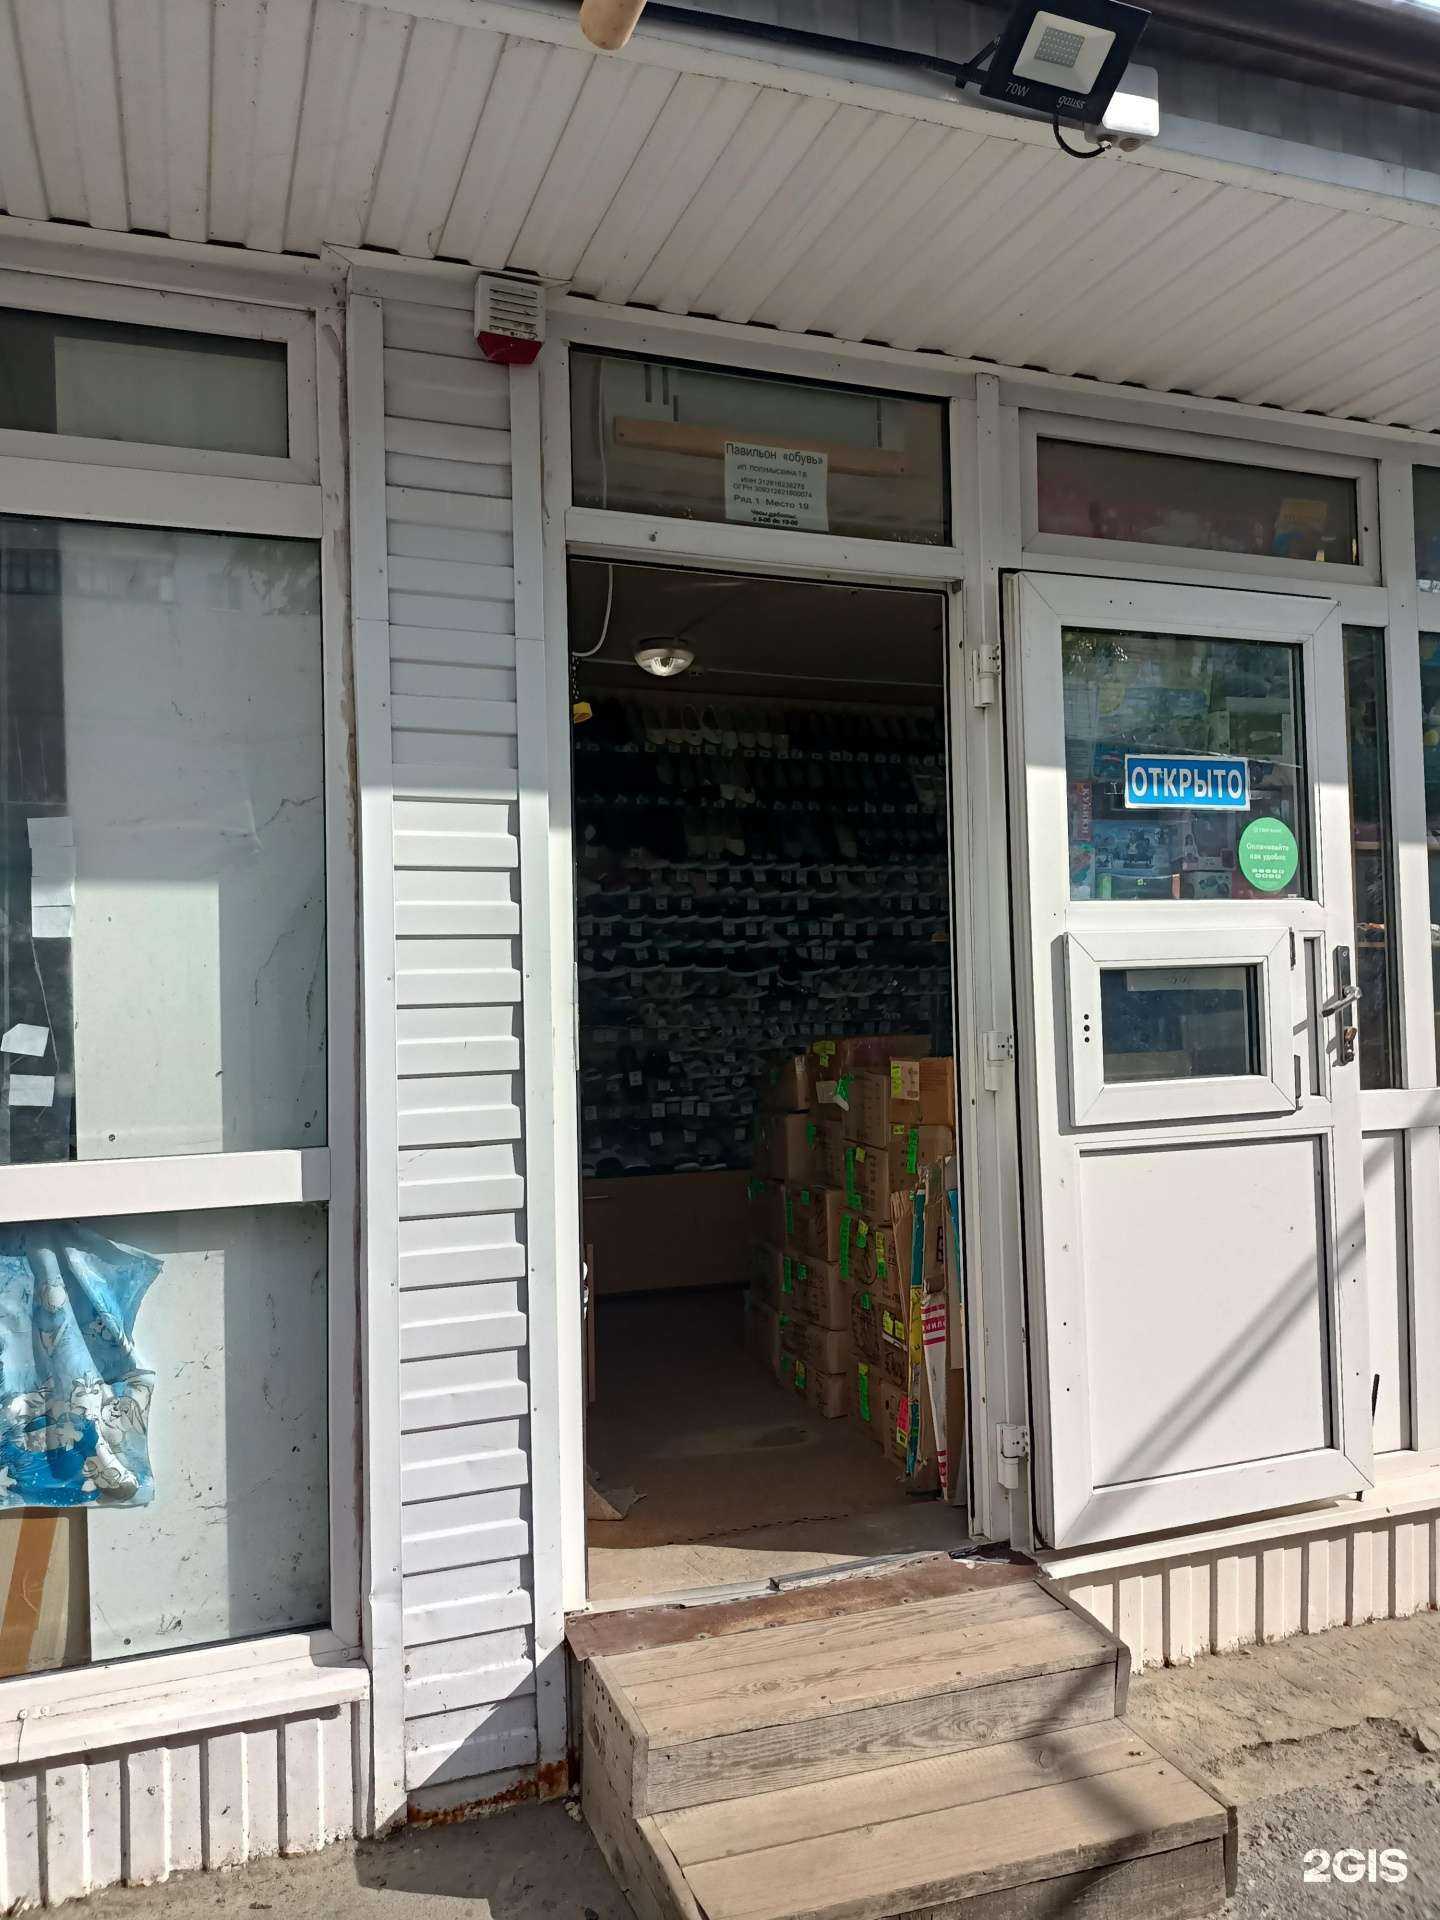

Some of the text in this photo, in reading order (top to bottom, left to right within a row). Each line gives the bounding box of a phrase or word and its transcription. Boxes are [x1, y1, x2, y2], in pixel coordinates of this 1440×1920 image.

[1005, 81, 1030, 97] 70W
[1056, 95, 1086, 110] gauss
[726, 443, 823, 466] Павильон «обувь»
[734, 494, 752, 504] Ряд
[766, 498, 795, 509] Место
[1131, 766, 1243, 799] ОТКРЫТО
